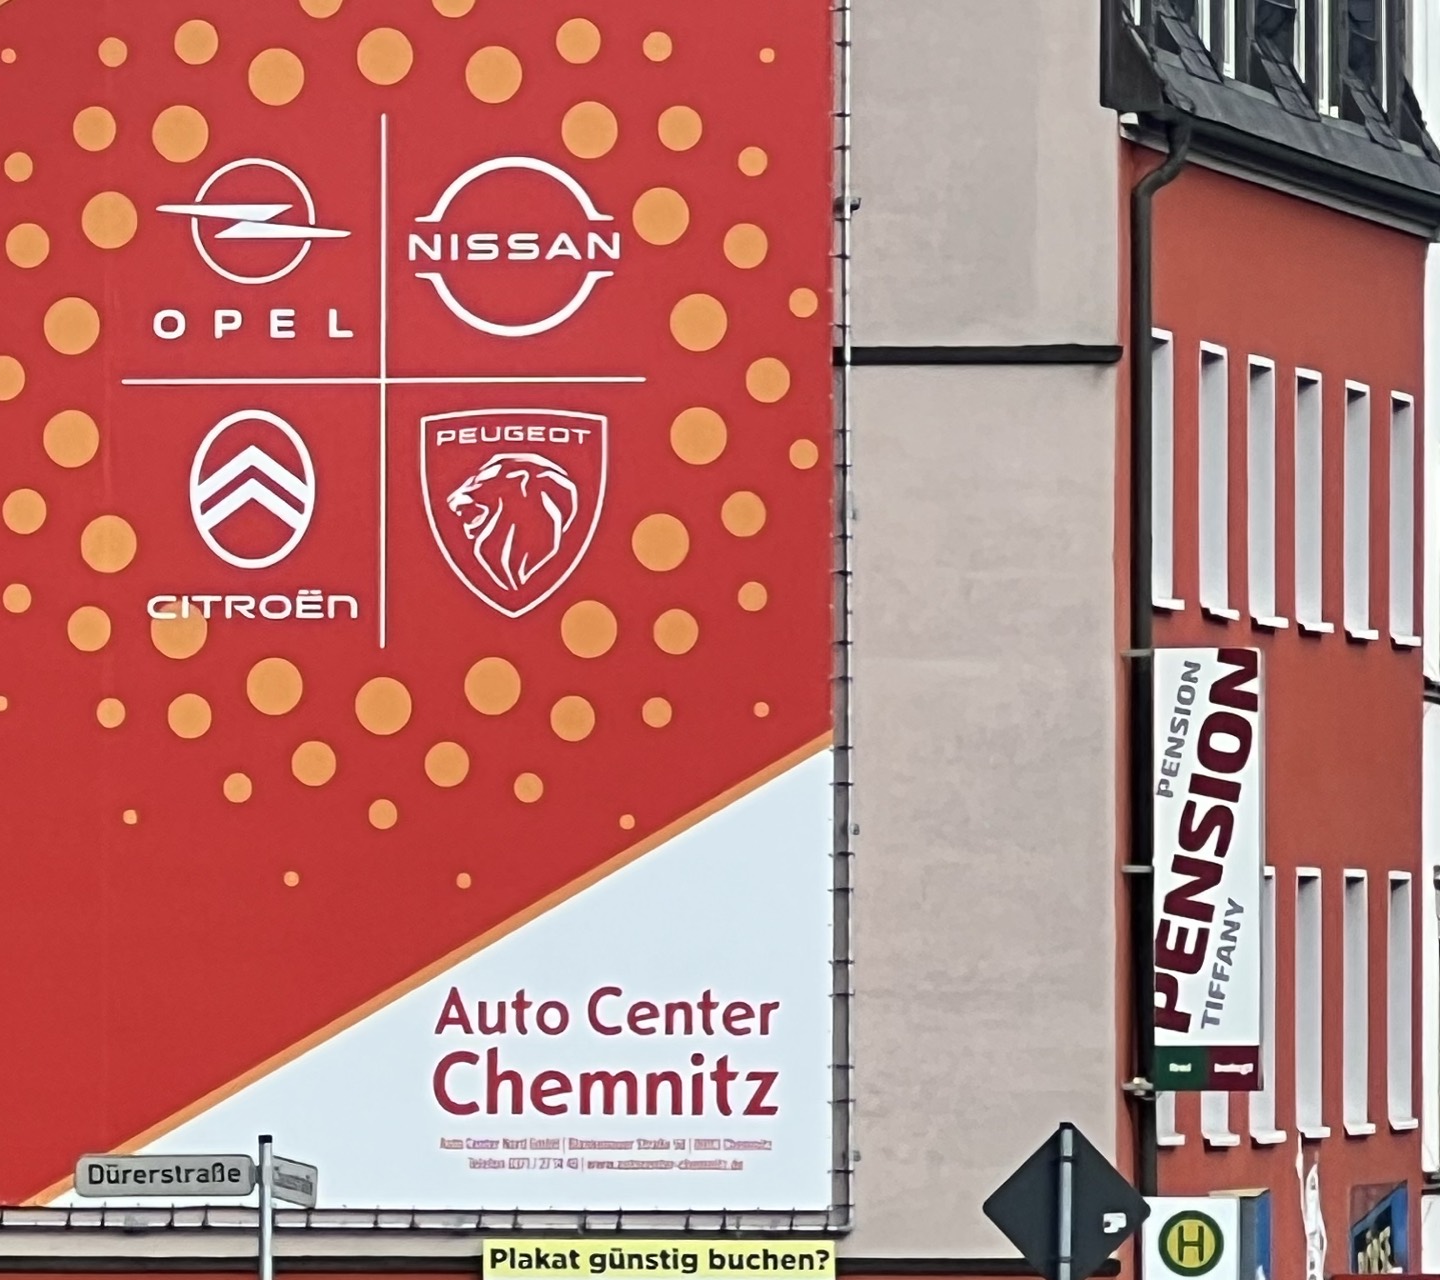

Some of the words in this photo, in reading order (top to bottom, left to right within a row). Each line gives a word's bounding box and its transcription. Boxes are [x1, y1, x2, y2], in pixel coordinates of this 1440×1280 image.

[153, 309, 354, 339] OPEL
[409, 232, 621, 261] NISSAN
[437, 425, 591, 446] PEUGEOT
[1155, 660, 1201, 799] PENSION
[1153, 648, 1258, 1033] PENSION
[1201, 897, 1245, 1030] TIFFANY
[435, 986, 569, 1036] Auto
[587, 986, 780, 1036] Center
[433, 1046, 780, 1116] Chemnitz
[88, 1163, 241, 1185] Dürerstraße
[490, 1248, 581, 1270] Plakat
[589, 1248, 698, 1274] günstig
[709, 1248, 830, 1271] buchen?
[1178, 1225, 1204, 1262] H
